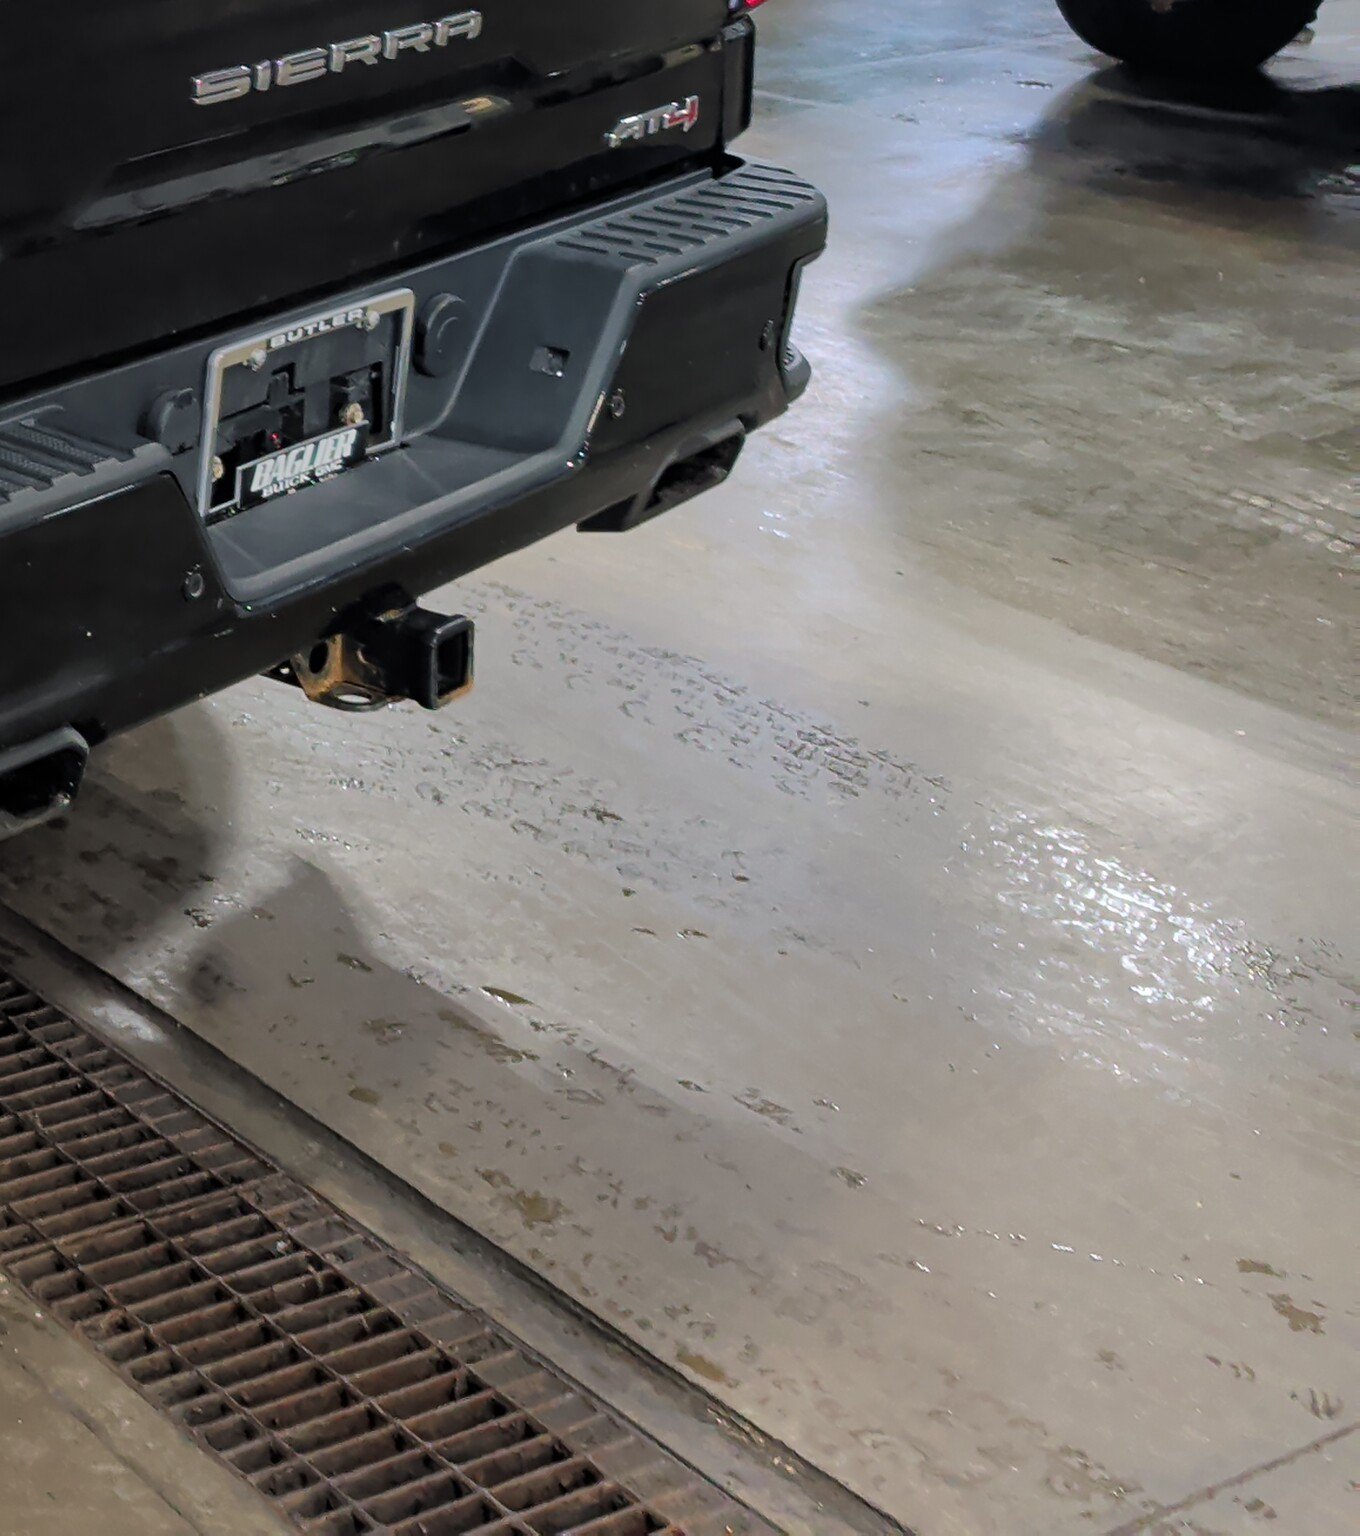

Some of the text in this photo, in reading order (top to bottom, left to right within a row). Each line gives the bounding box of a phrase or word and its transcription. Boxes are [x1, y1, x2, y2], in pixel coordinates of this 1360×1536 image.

[191, 10, 482, 105] SIERRA
[604, 95, 699, 148] AT4
[270, 308, 364, 348] BUTLER
